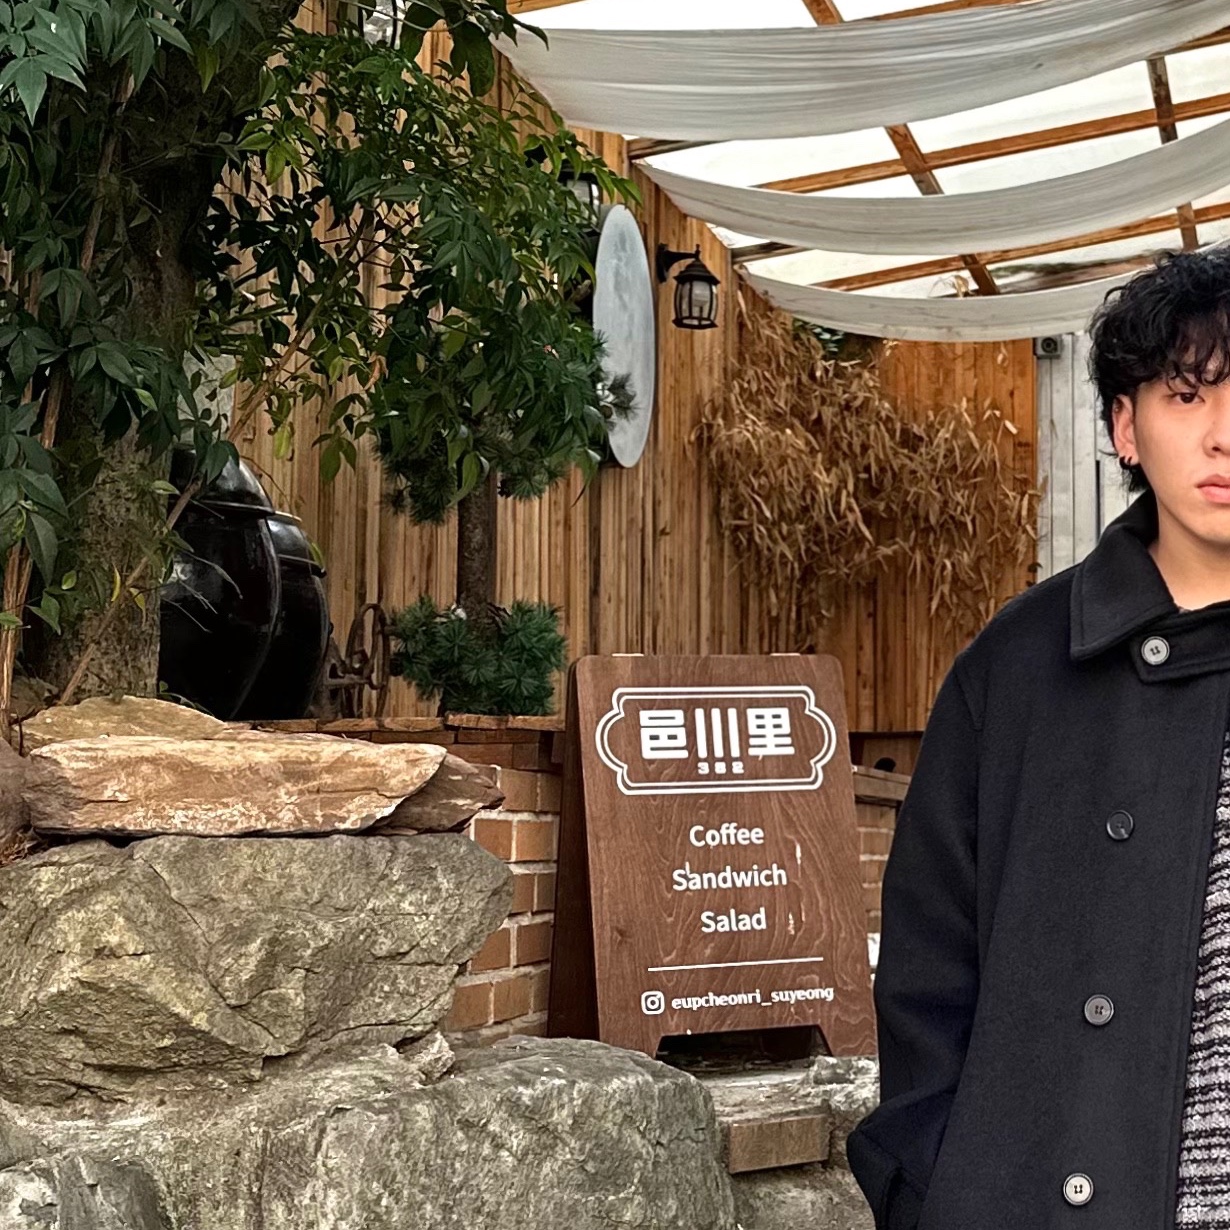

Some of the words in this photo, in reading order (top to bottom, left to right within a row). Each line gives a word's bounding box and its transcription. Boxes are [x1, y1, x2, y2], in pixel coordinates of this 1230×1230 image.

[697, 761, 744, 775] 382
[689, 822, 764, 847] Coffee
[672, 863, 788, 891] Sandwich
[700, 907, 767, 933] Salad
[671, 987, 835, 1011] eupcheonri_suyeong
